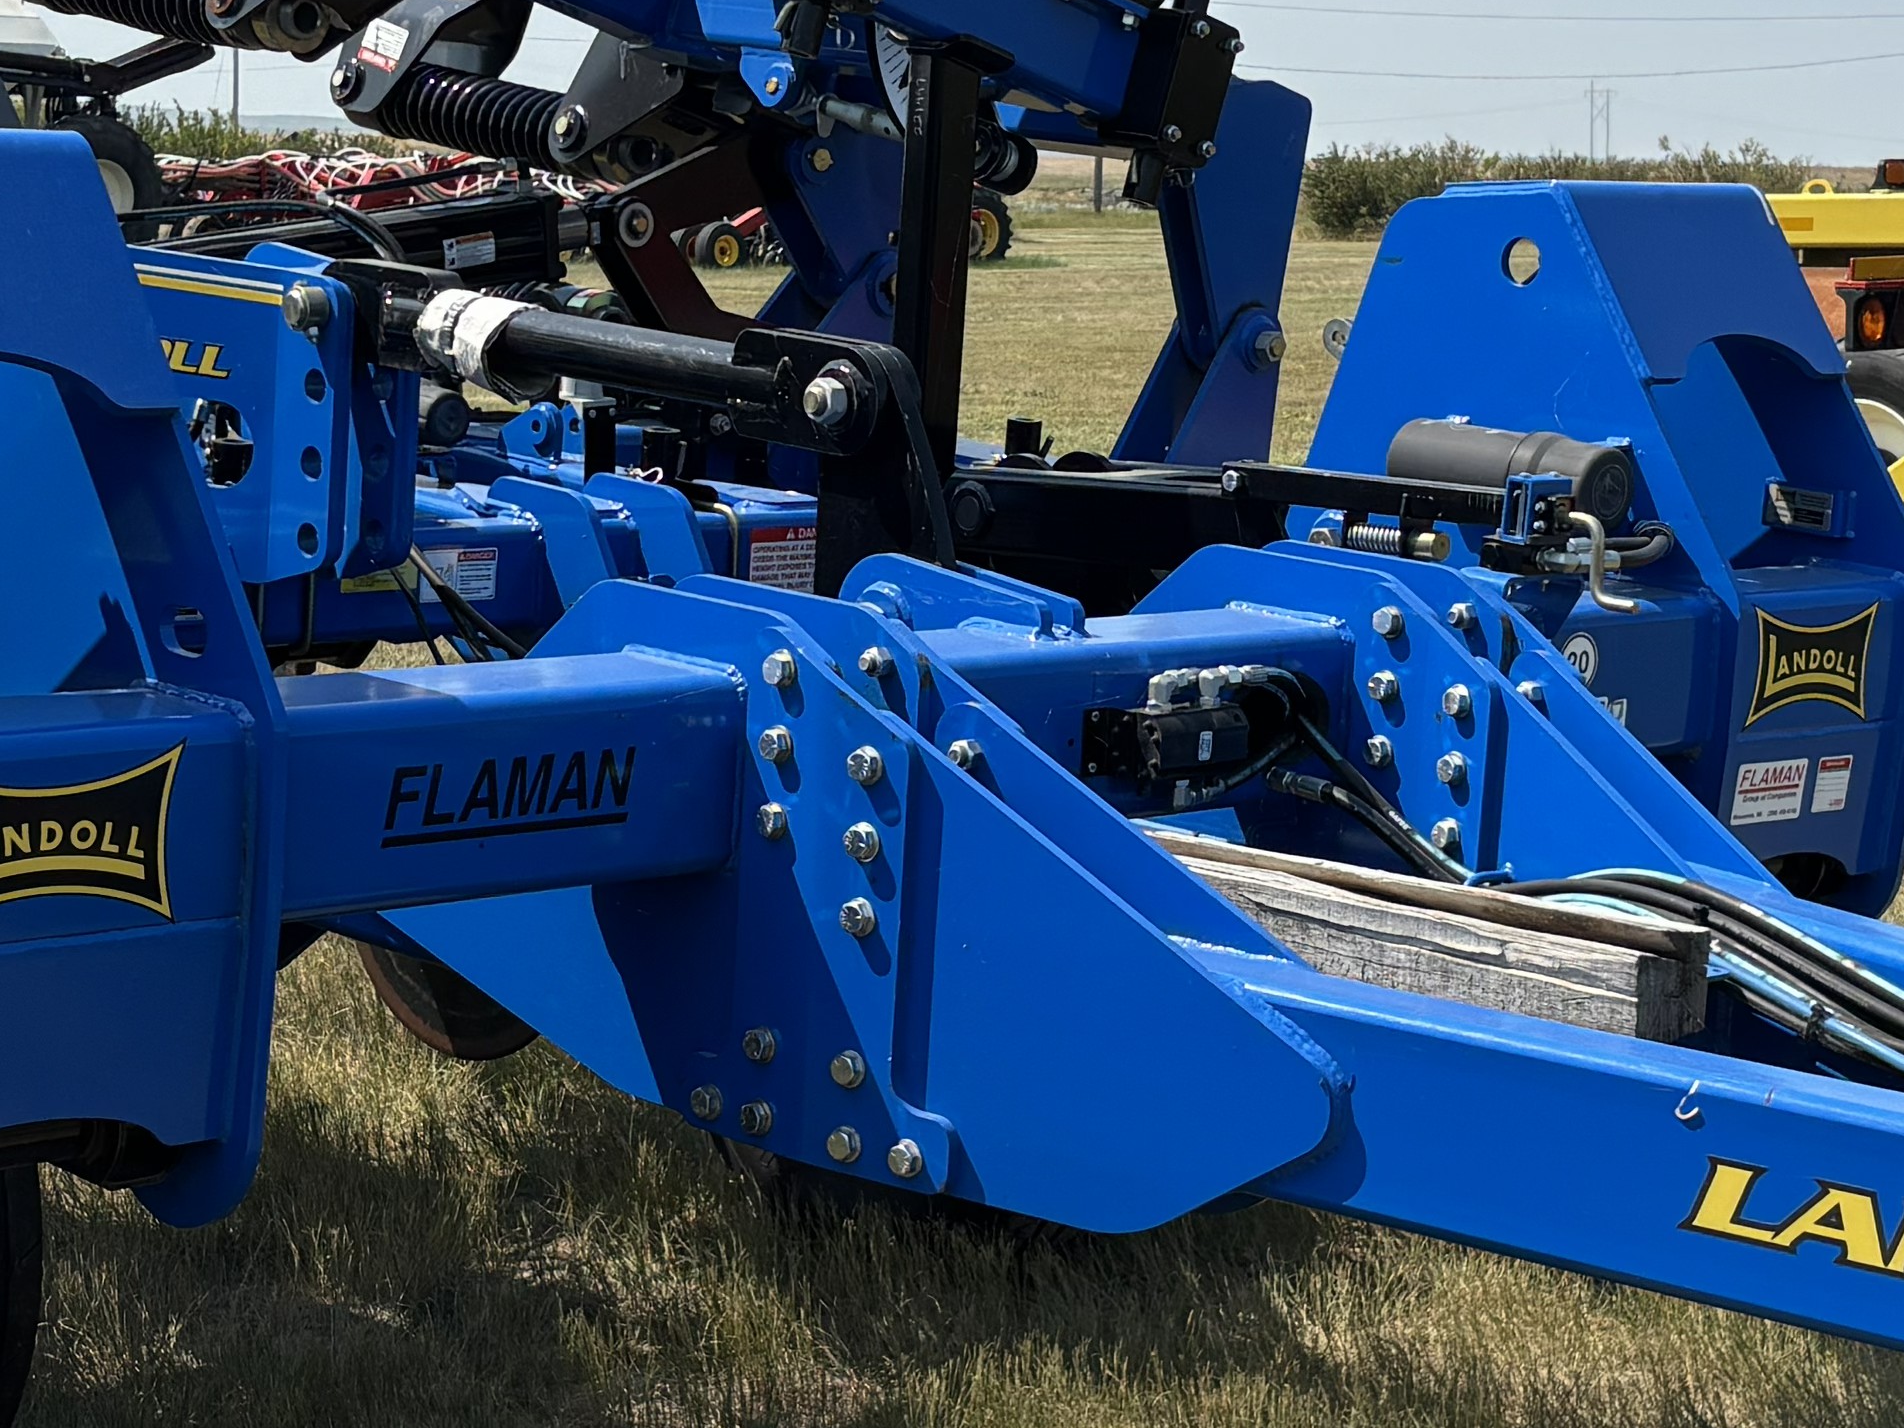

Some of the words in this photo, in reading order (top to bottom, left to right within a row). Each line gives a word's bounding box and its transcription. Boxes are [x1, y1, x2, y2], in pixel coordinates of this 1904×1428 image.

[1763, 634, 1856, 699] LANDOLL
[384, 746, 637, 831] FLAMAN
[1739, 764, 1805, 788] FLAMAN
